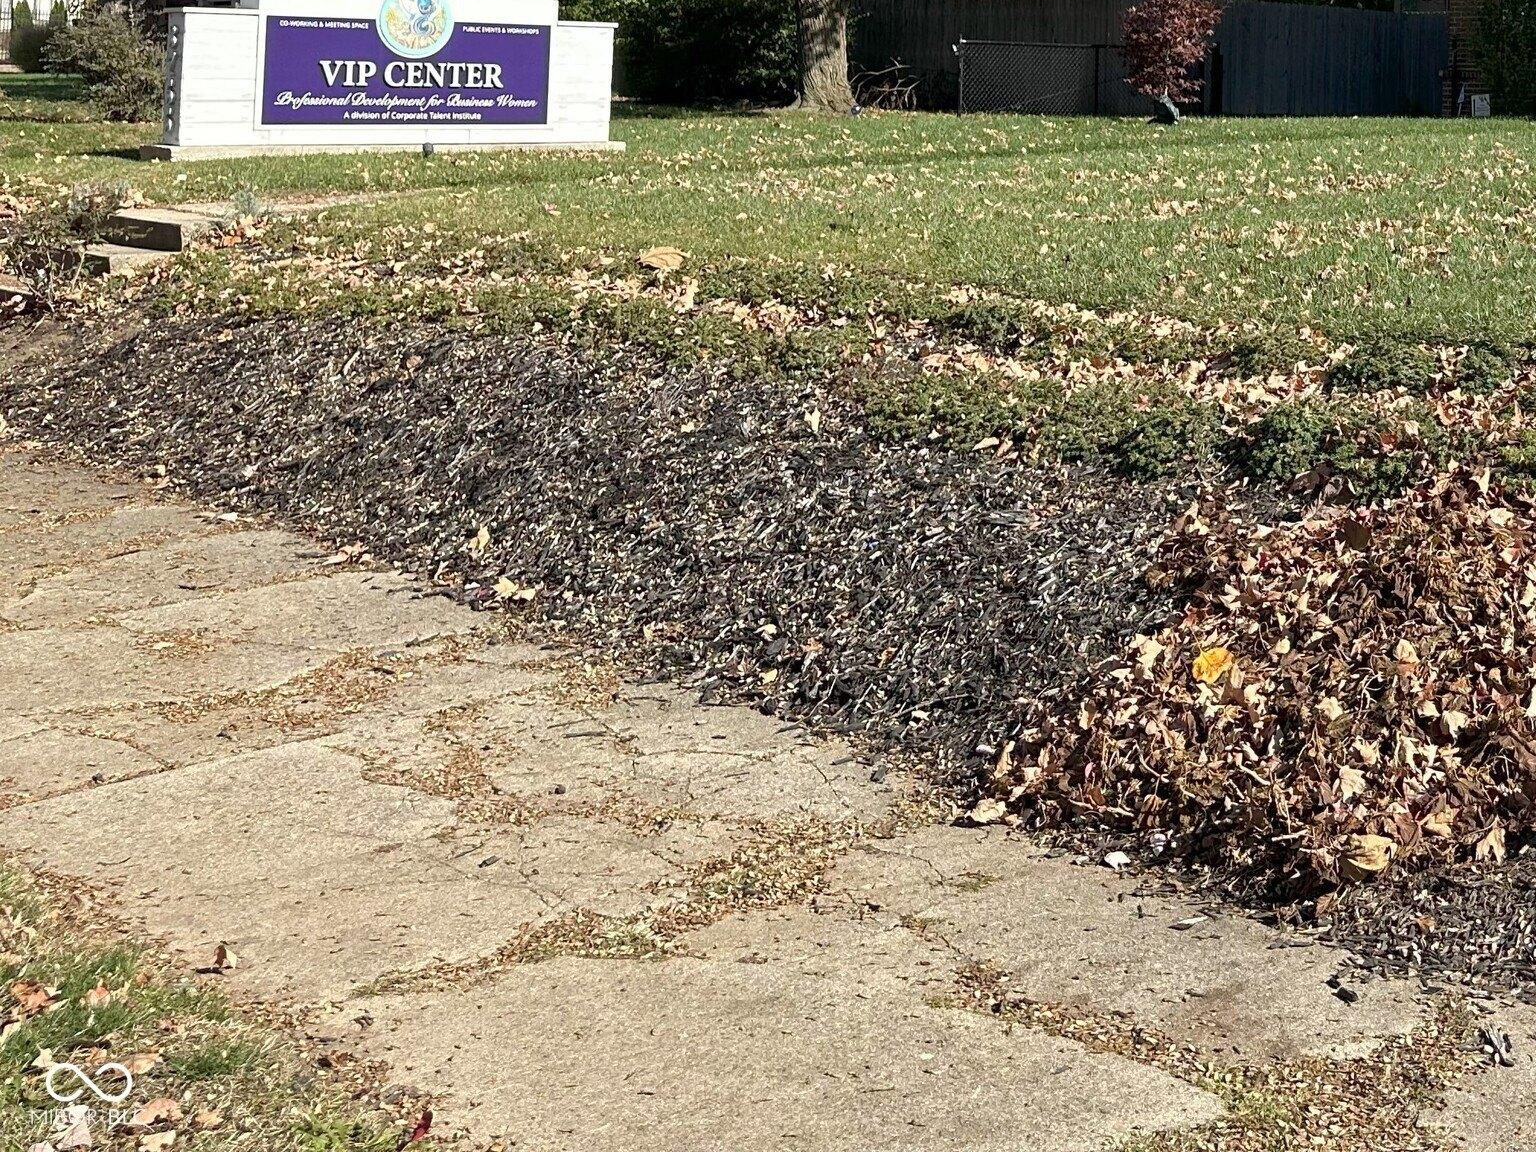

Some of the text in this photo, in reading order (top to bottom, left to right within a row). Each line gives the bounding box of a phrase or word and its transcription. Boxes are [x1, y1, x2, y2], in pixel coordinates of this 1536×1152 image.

[279, 20, 318, 28] CO-WORKING
[325, 21, 350, 29] MEETING
[352, 22, 369, 30] SPACE
[482, 26, 501, 34] EVENTS
[507, 27, 539, 35] WORKSHOPS
[319, 60, 504, 88] VIP CENTER
[274, 91, 538, 111] Professional Development for Business Women
[343, 111, 482, 121] A division of Corporate Talent Institute
